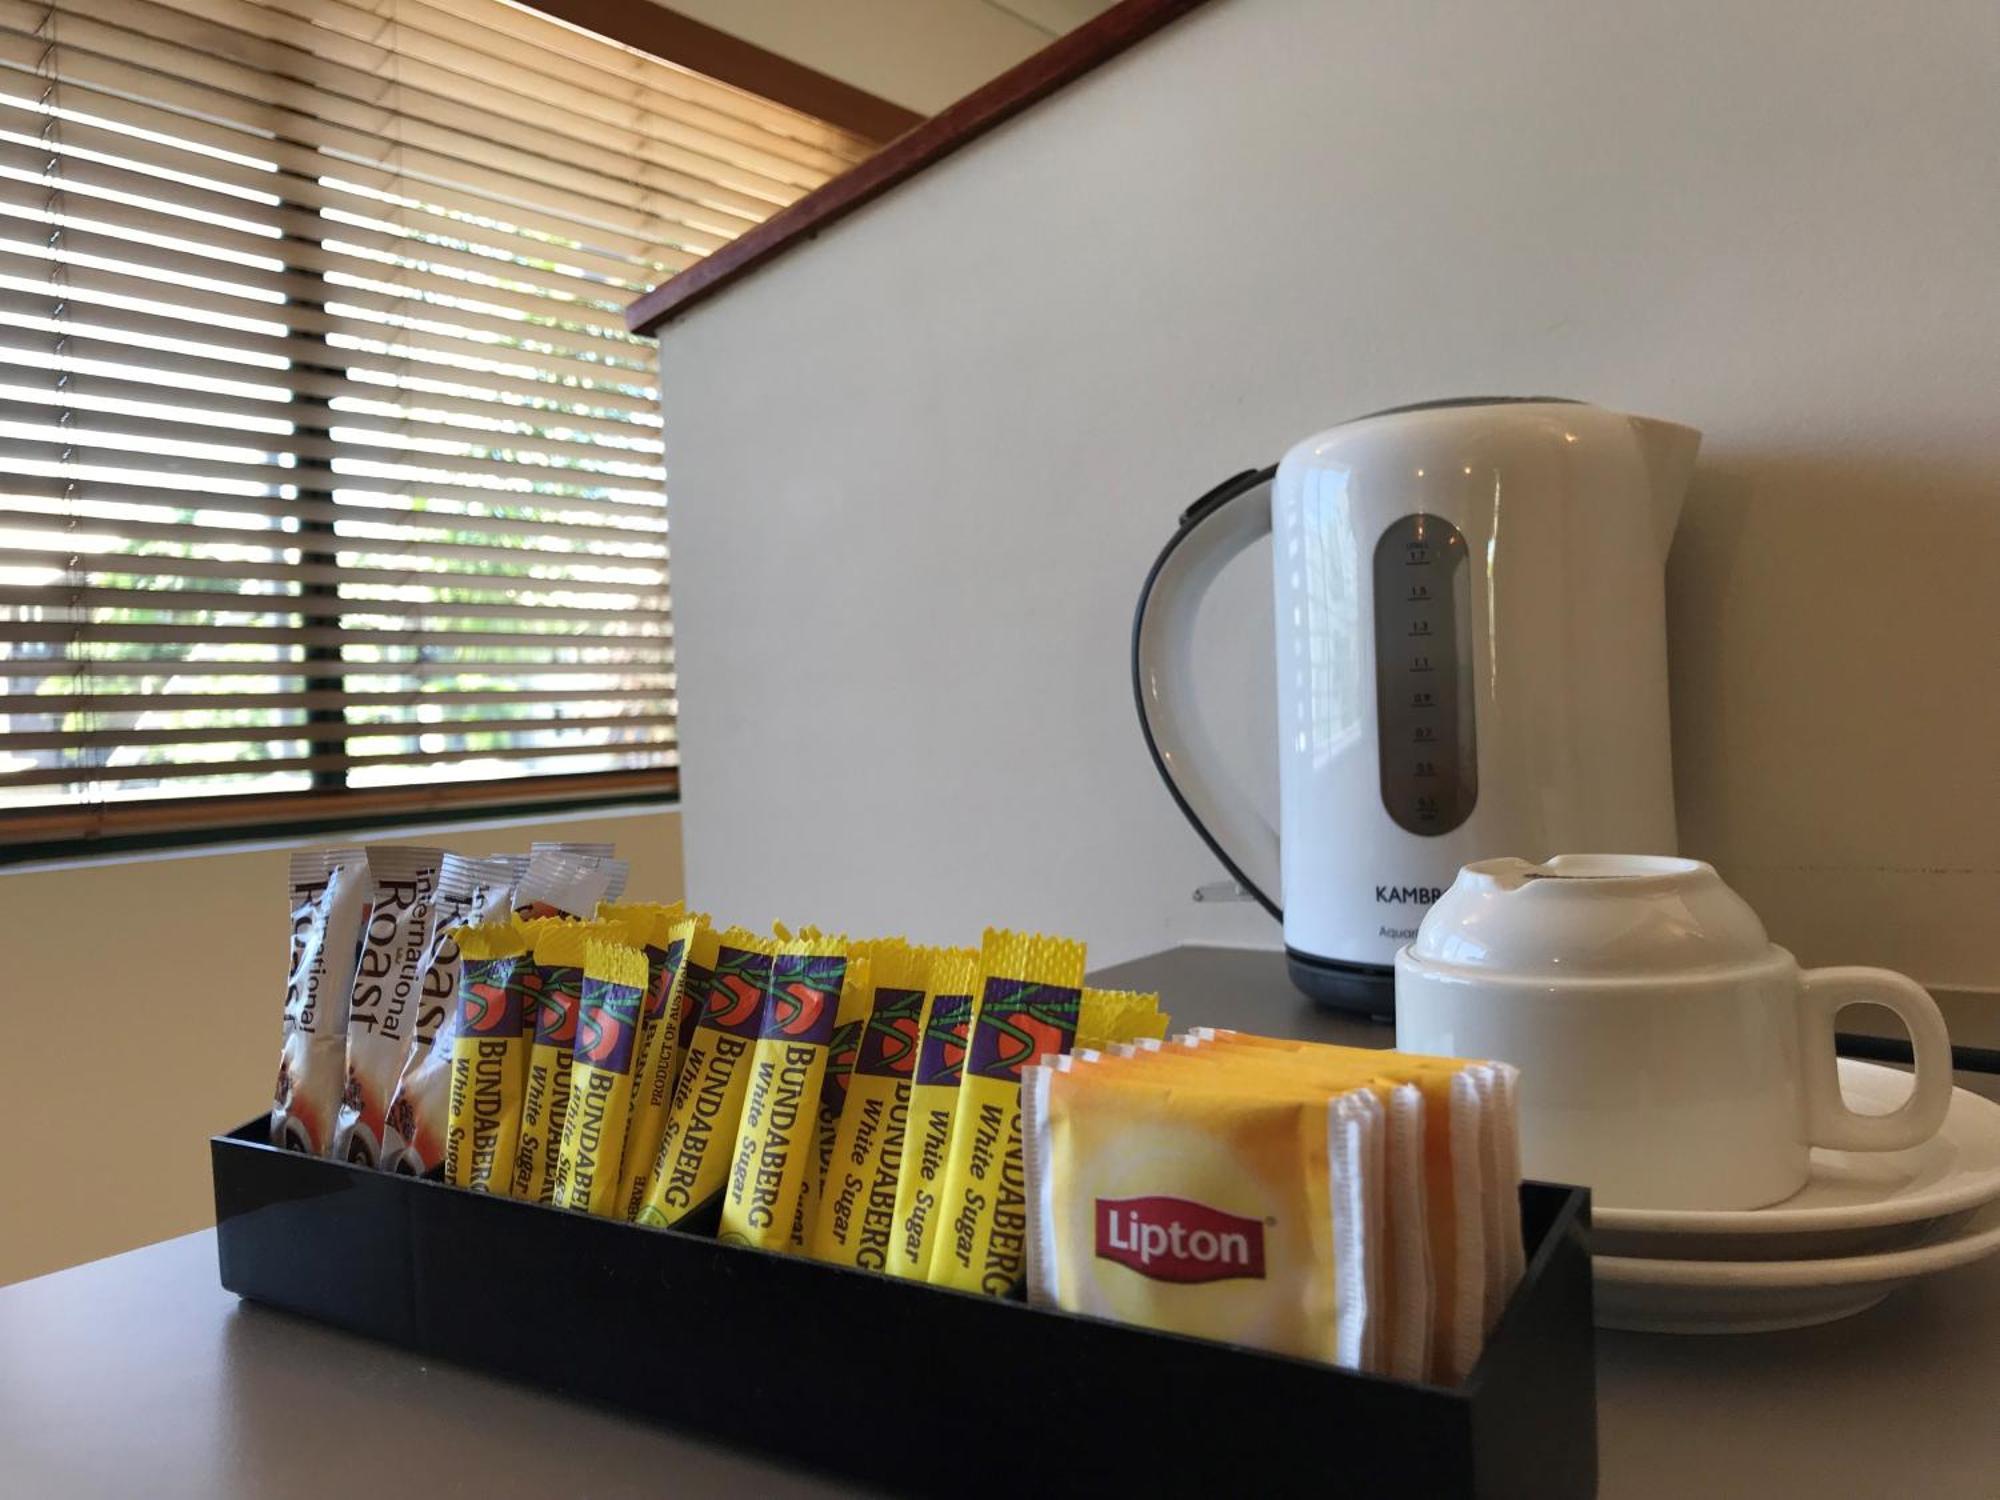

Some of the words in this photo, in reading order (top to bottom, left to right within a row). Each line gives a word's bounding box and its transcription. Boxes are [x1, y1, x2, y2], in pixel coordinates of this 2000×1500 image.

[350, 880, 418, 1034] Roast
[453, 1058, 470, 1117] White
[525, 1065, 548, 1126] White
[651, 1042, 673, 1107] PRODUCT
[664, 1022, 677, 1041] OF
[676, 1048, 705, 1110] White
[748, 1062, 775, 1128] White
[539, 1050, 573, 1203] BUNDABER
[665, 1035, 747, 1209] BUNDABERG
[748, 1044, 817, 1229] BUNDABERG
[851, 1098, 884, 1166] White
[921, 1109, 950, 1181] White
[970, 1103, 1004, 1180] White
[513, 1133, 539, 1194] Sugar
[732, 1136, 757, 1206] Sugar
[856, 1081, 912, 1270] BUNDABERG
[982, 1087, 1026, 1295] UNDABERG
[833, 1173, 863, 1246] Sugar
[905, 1189, 934, 1265] Sugar
[955, 1188, 986, 1269] Sugar
[1108, 1209, 1249, 1265] Lipton
